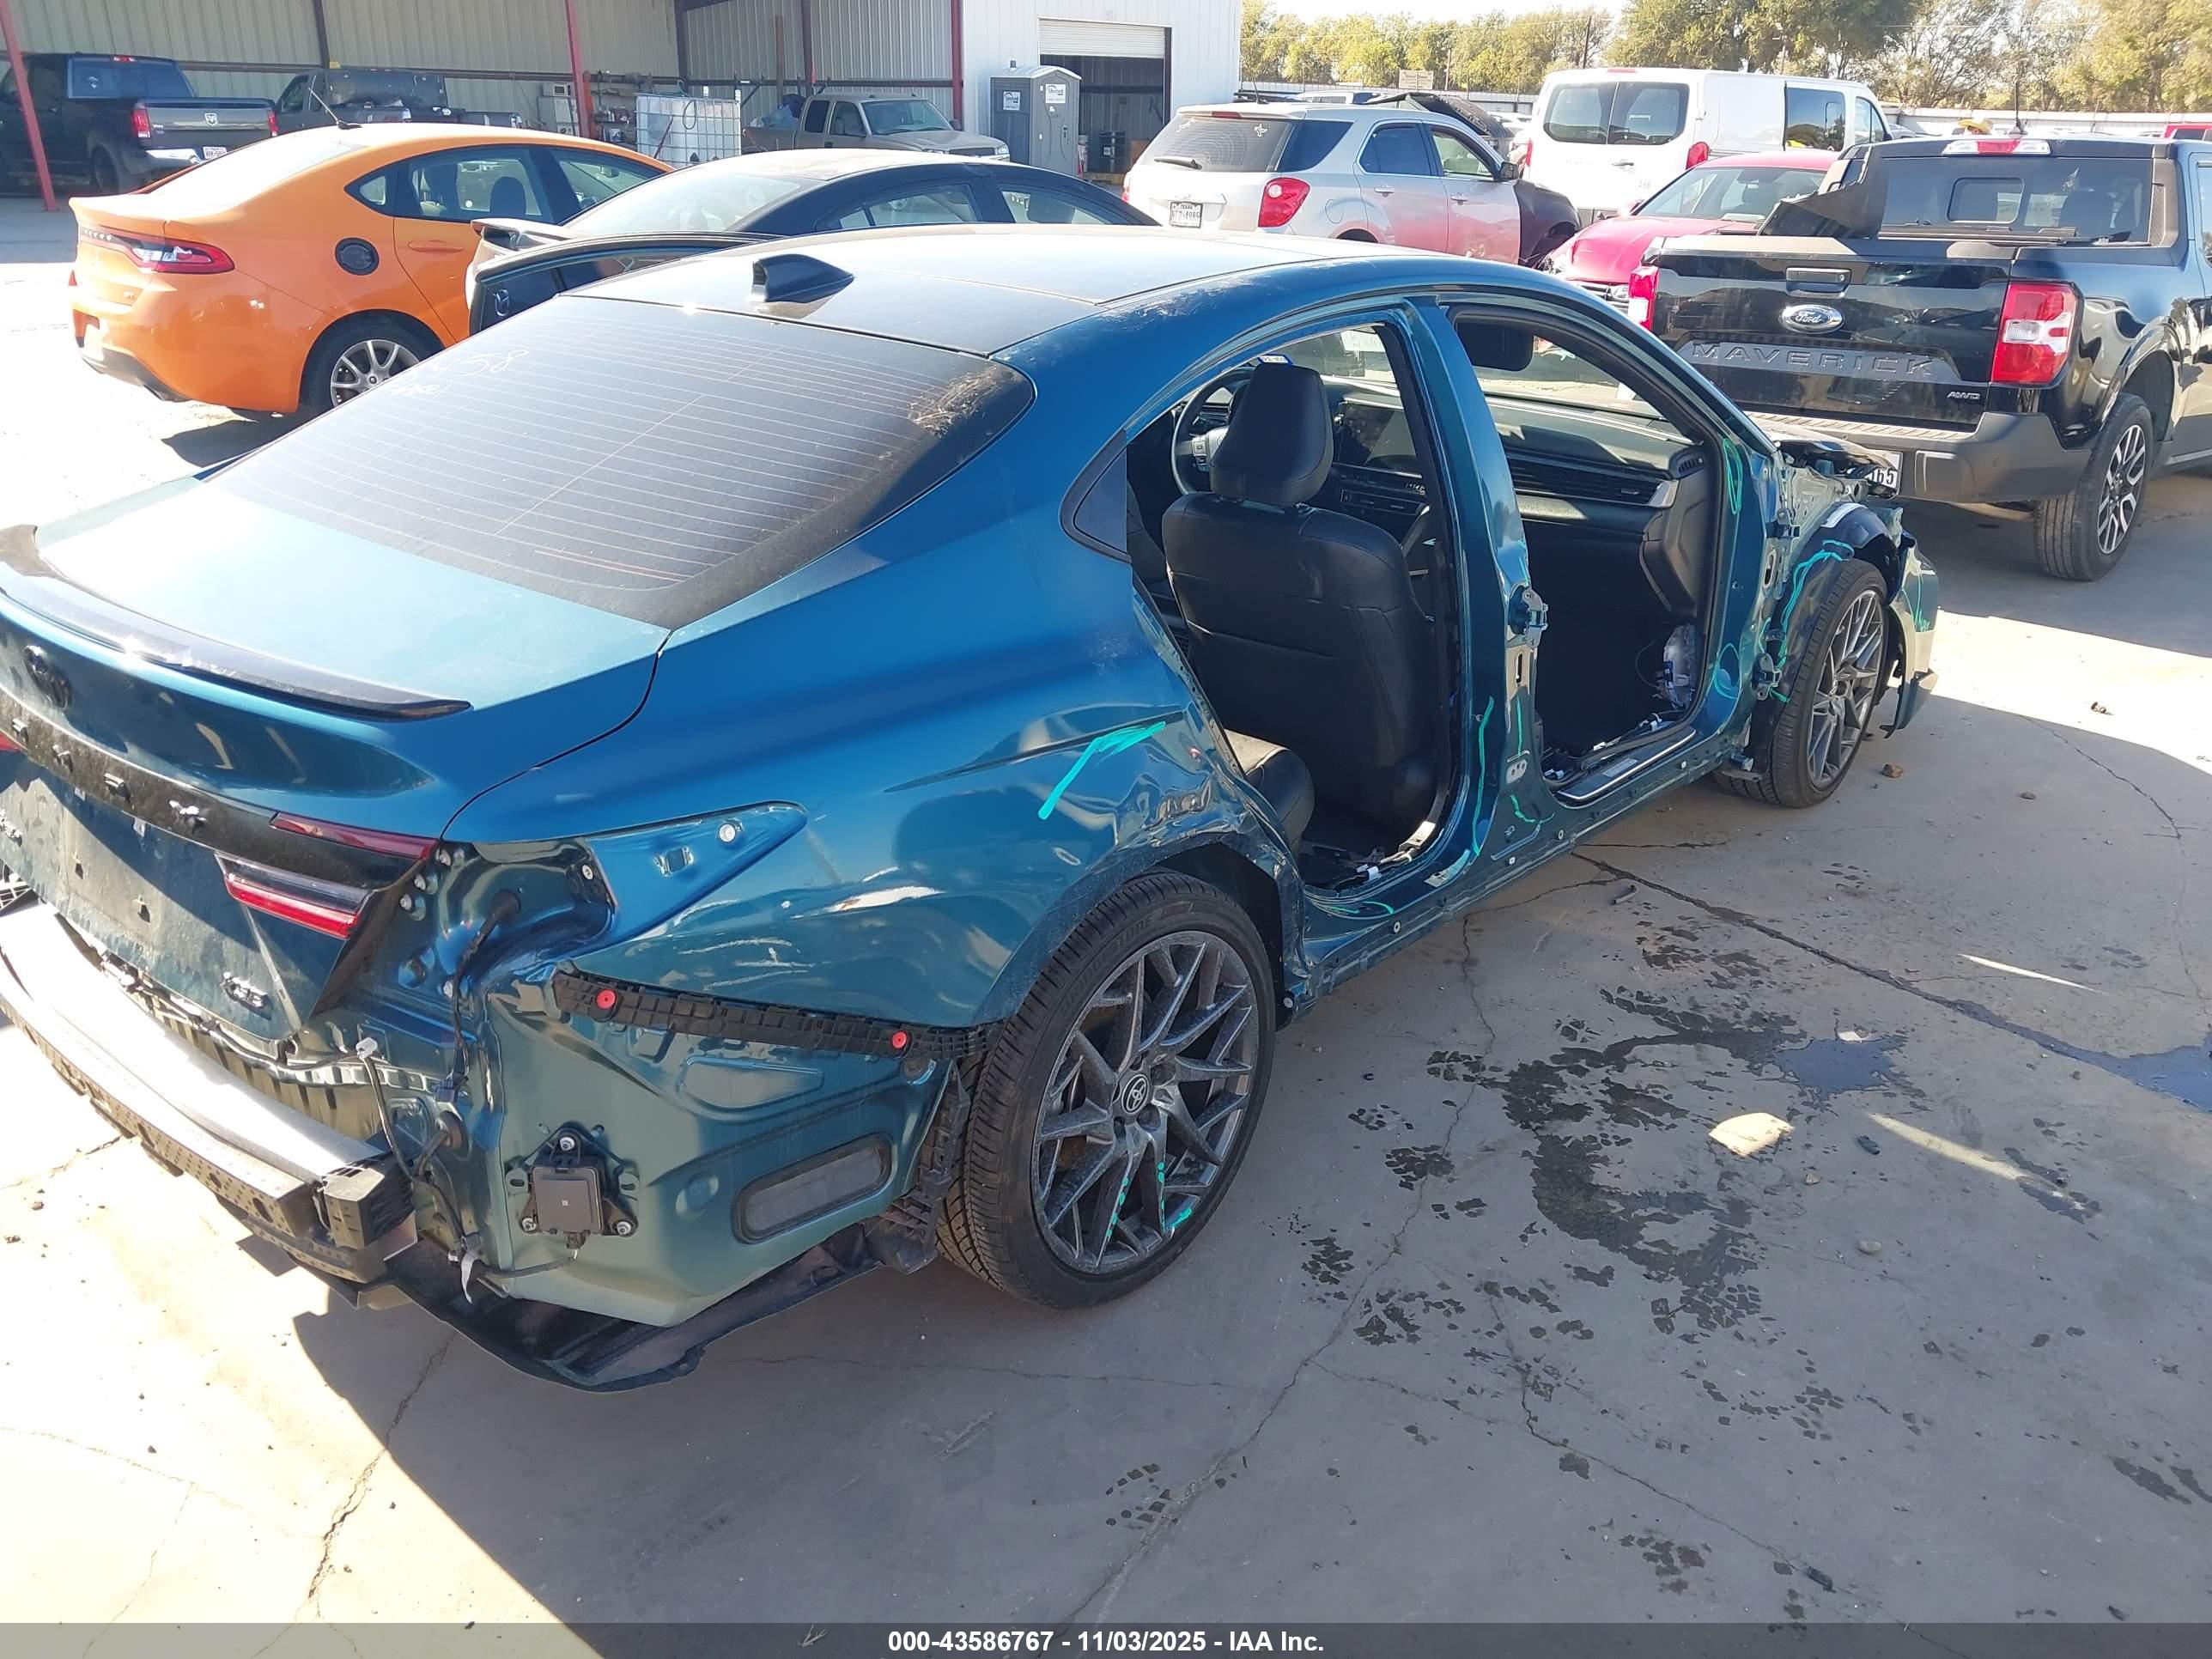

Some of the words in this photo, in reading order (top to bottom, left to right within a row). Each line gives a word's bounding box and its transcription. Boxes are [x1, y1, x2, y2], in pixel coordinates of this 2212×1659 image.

[1795, 311, 1824, 324] Ford
[1692, 343, 1935, 375] MAVERICK
[1946, 391, 1981, 401] AWD
